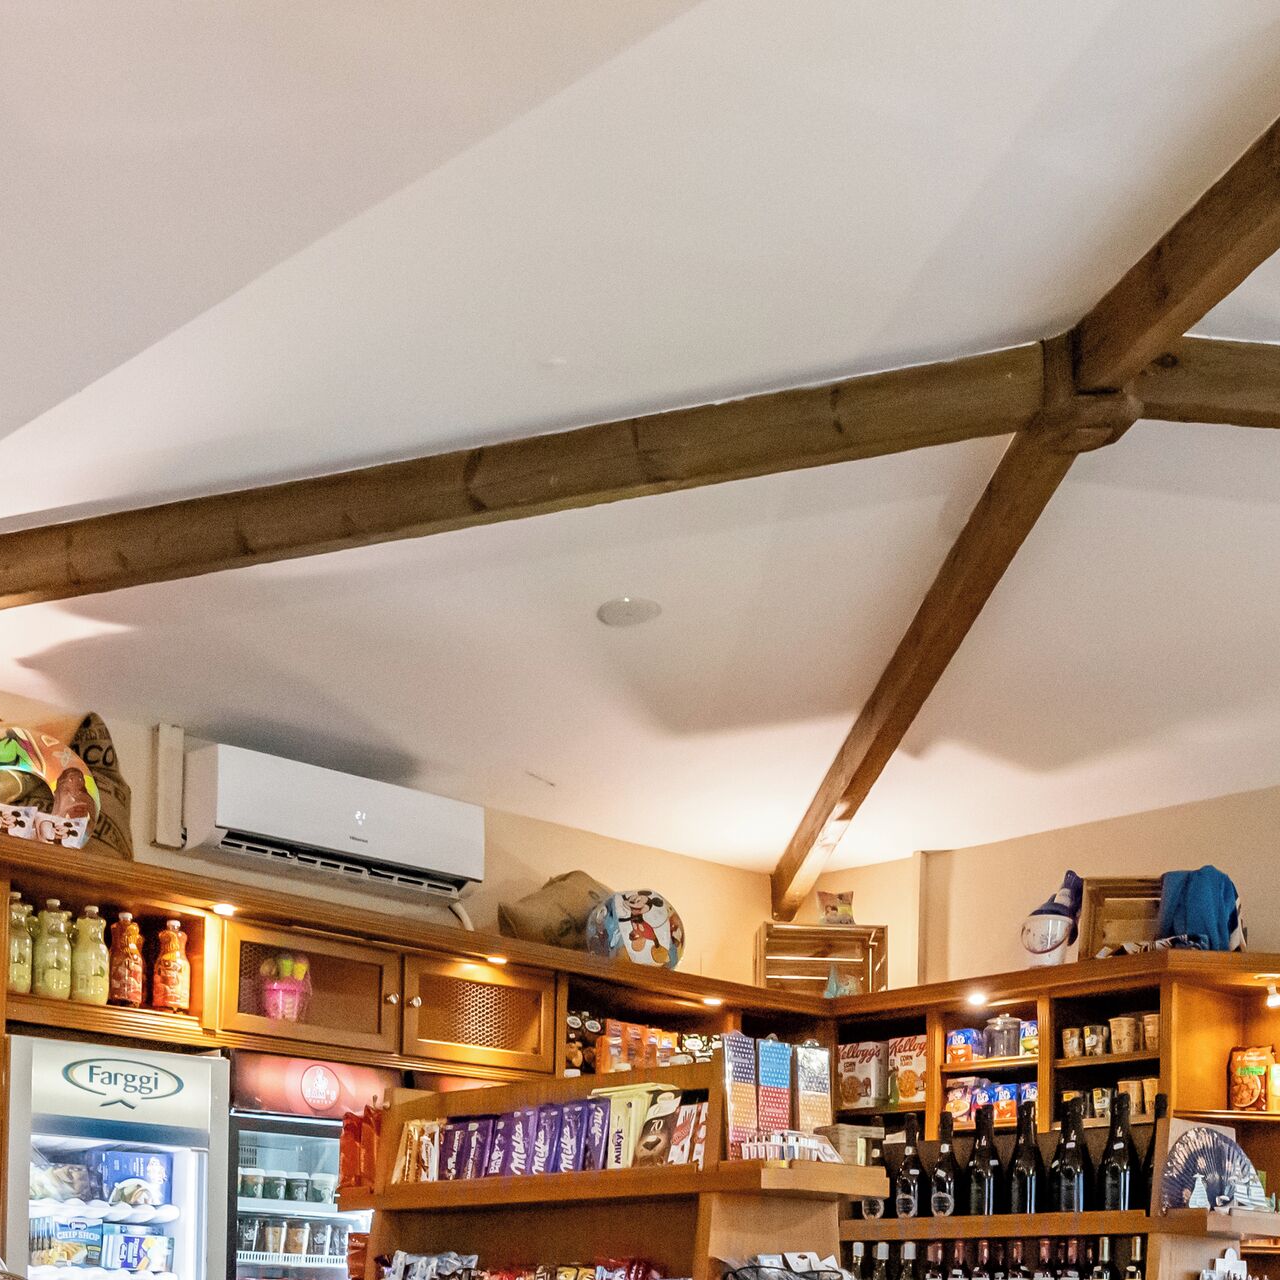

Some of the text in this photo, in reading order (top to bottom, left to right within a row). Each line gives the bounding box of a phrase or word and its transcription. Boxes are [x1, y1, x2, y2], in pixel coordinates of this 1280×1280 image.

[88, 1064, 160, 1095] Farggi
[510, 1121, 526, 1176] Milka
[532, 1129, 546, 1175] Milka
[560, 1124, 575, 1173] Milka
